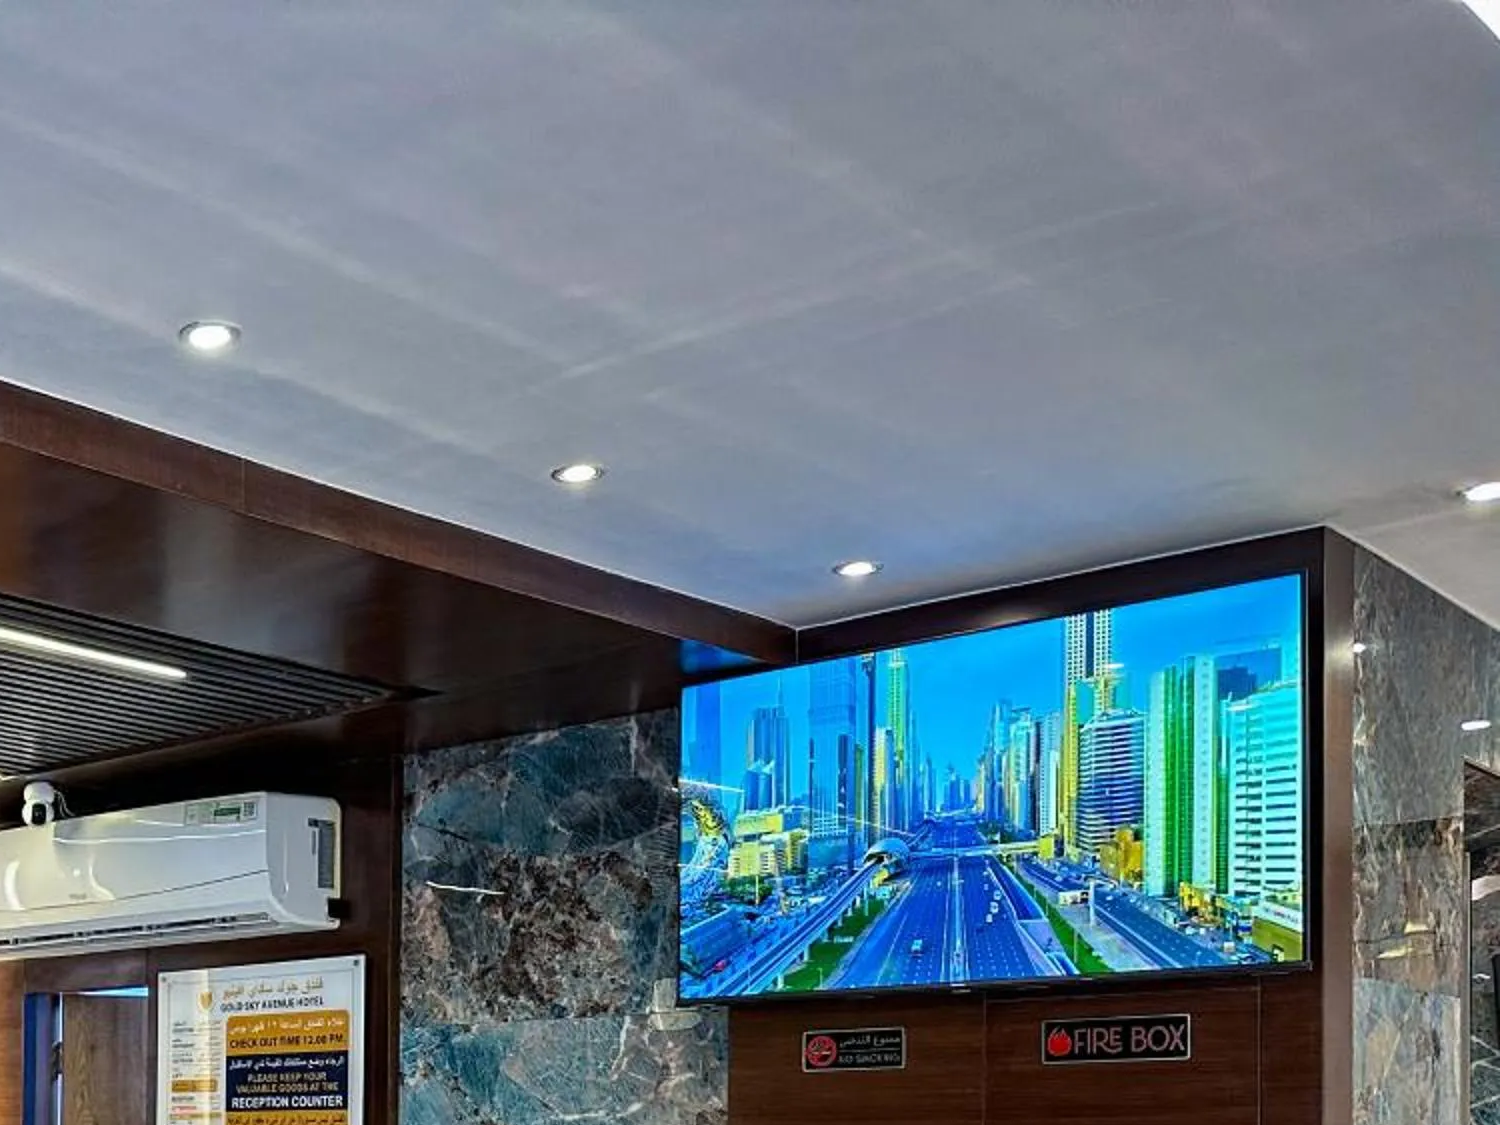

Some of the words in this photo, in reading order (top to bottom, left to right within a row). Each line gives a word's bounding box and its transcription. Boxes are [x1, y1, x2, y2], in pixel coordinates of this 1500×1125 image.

[245, 1000, 260, 1010] SKY
[262, 998, 295, 1009] AVENUE
[297, 996, 324, 1007] HOTEL
[230, 1039, 259, 1049] CHECK
[260, 1037, 277, 1047] OUT
[280, 1036, 300, 1046] TIME
[1073, 1027, 1123, 1055] FIRE
[1130, 1024, 1186, 1053] BOX
[248, 1073, 278, 1083] PLEASE
[280, 1072, 301, 1082] KEEP
[304, 1071, 327, 1081] YOUR
[236, 1083, 278, 1094] VALUABLE
[279, 1082, 308, 1093] GOODS
[309, 1082, 320, 1092] AT
[322, 1081, 338, 1091] THE
[231, 1097, 288, 1109] RECEPTION
[291, 1095, 343, 1108] COUNTER
